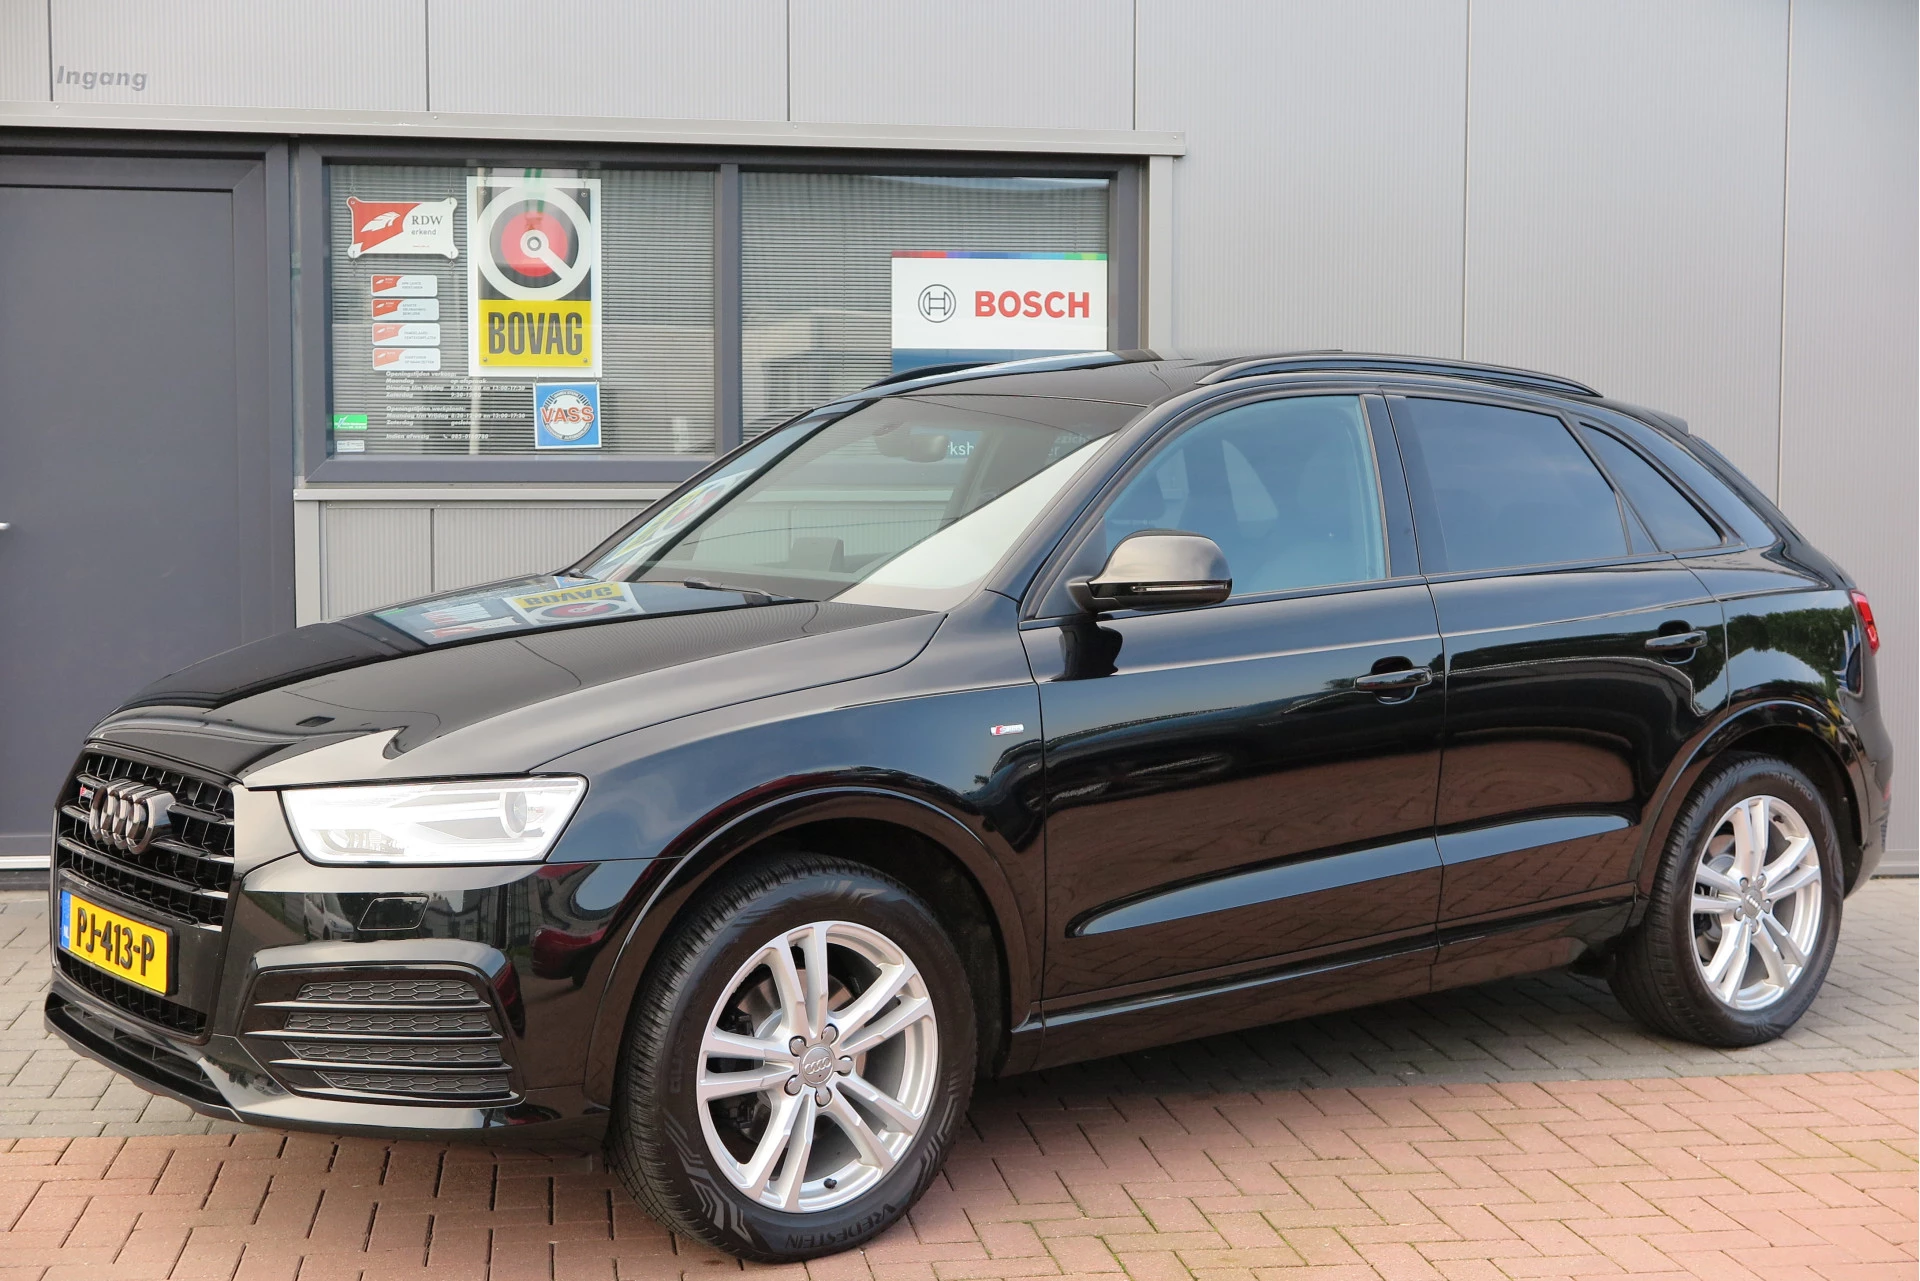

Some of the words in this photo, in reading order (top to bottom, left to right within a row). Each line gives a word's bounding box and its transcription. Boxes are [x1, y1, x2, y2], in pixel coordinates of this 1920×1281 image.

[57, 65, 147, 91] Ingang
[411, 215, 443, 225] RDW
[411, 228, 437, 236] erkend
[975, 290, 1090, 318] BOSCH
[488, 311, 583, 356] BOVAG
[541, 406, 594, 423] VASS
[947, 440, 975, 456] ksh
[77, 906, 155, 977] PJ-413-P
